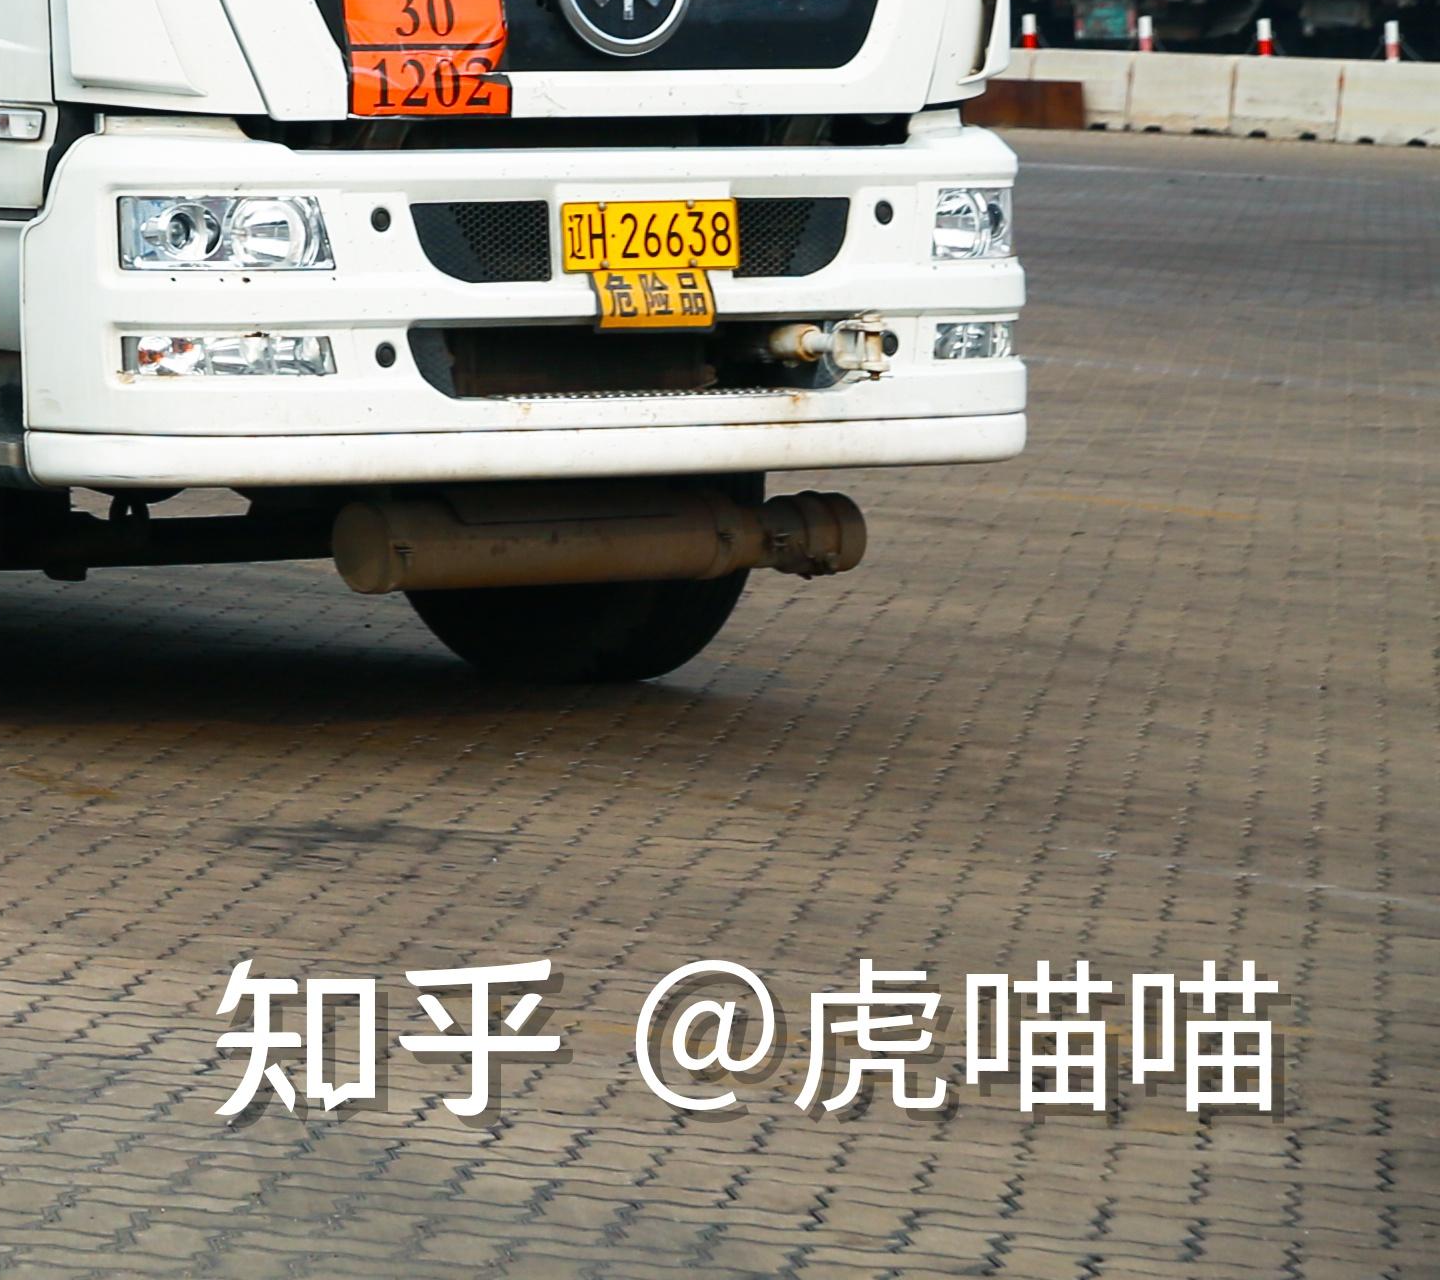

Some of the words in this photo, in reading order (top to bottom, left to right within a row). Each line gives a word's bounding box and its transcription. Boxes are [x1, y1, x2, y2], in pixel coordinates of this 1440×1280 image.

[372, 57, 493, 108] 1202
[603, 272, 708, 318] 危险品
